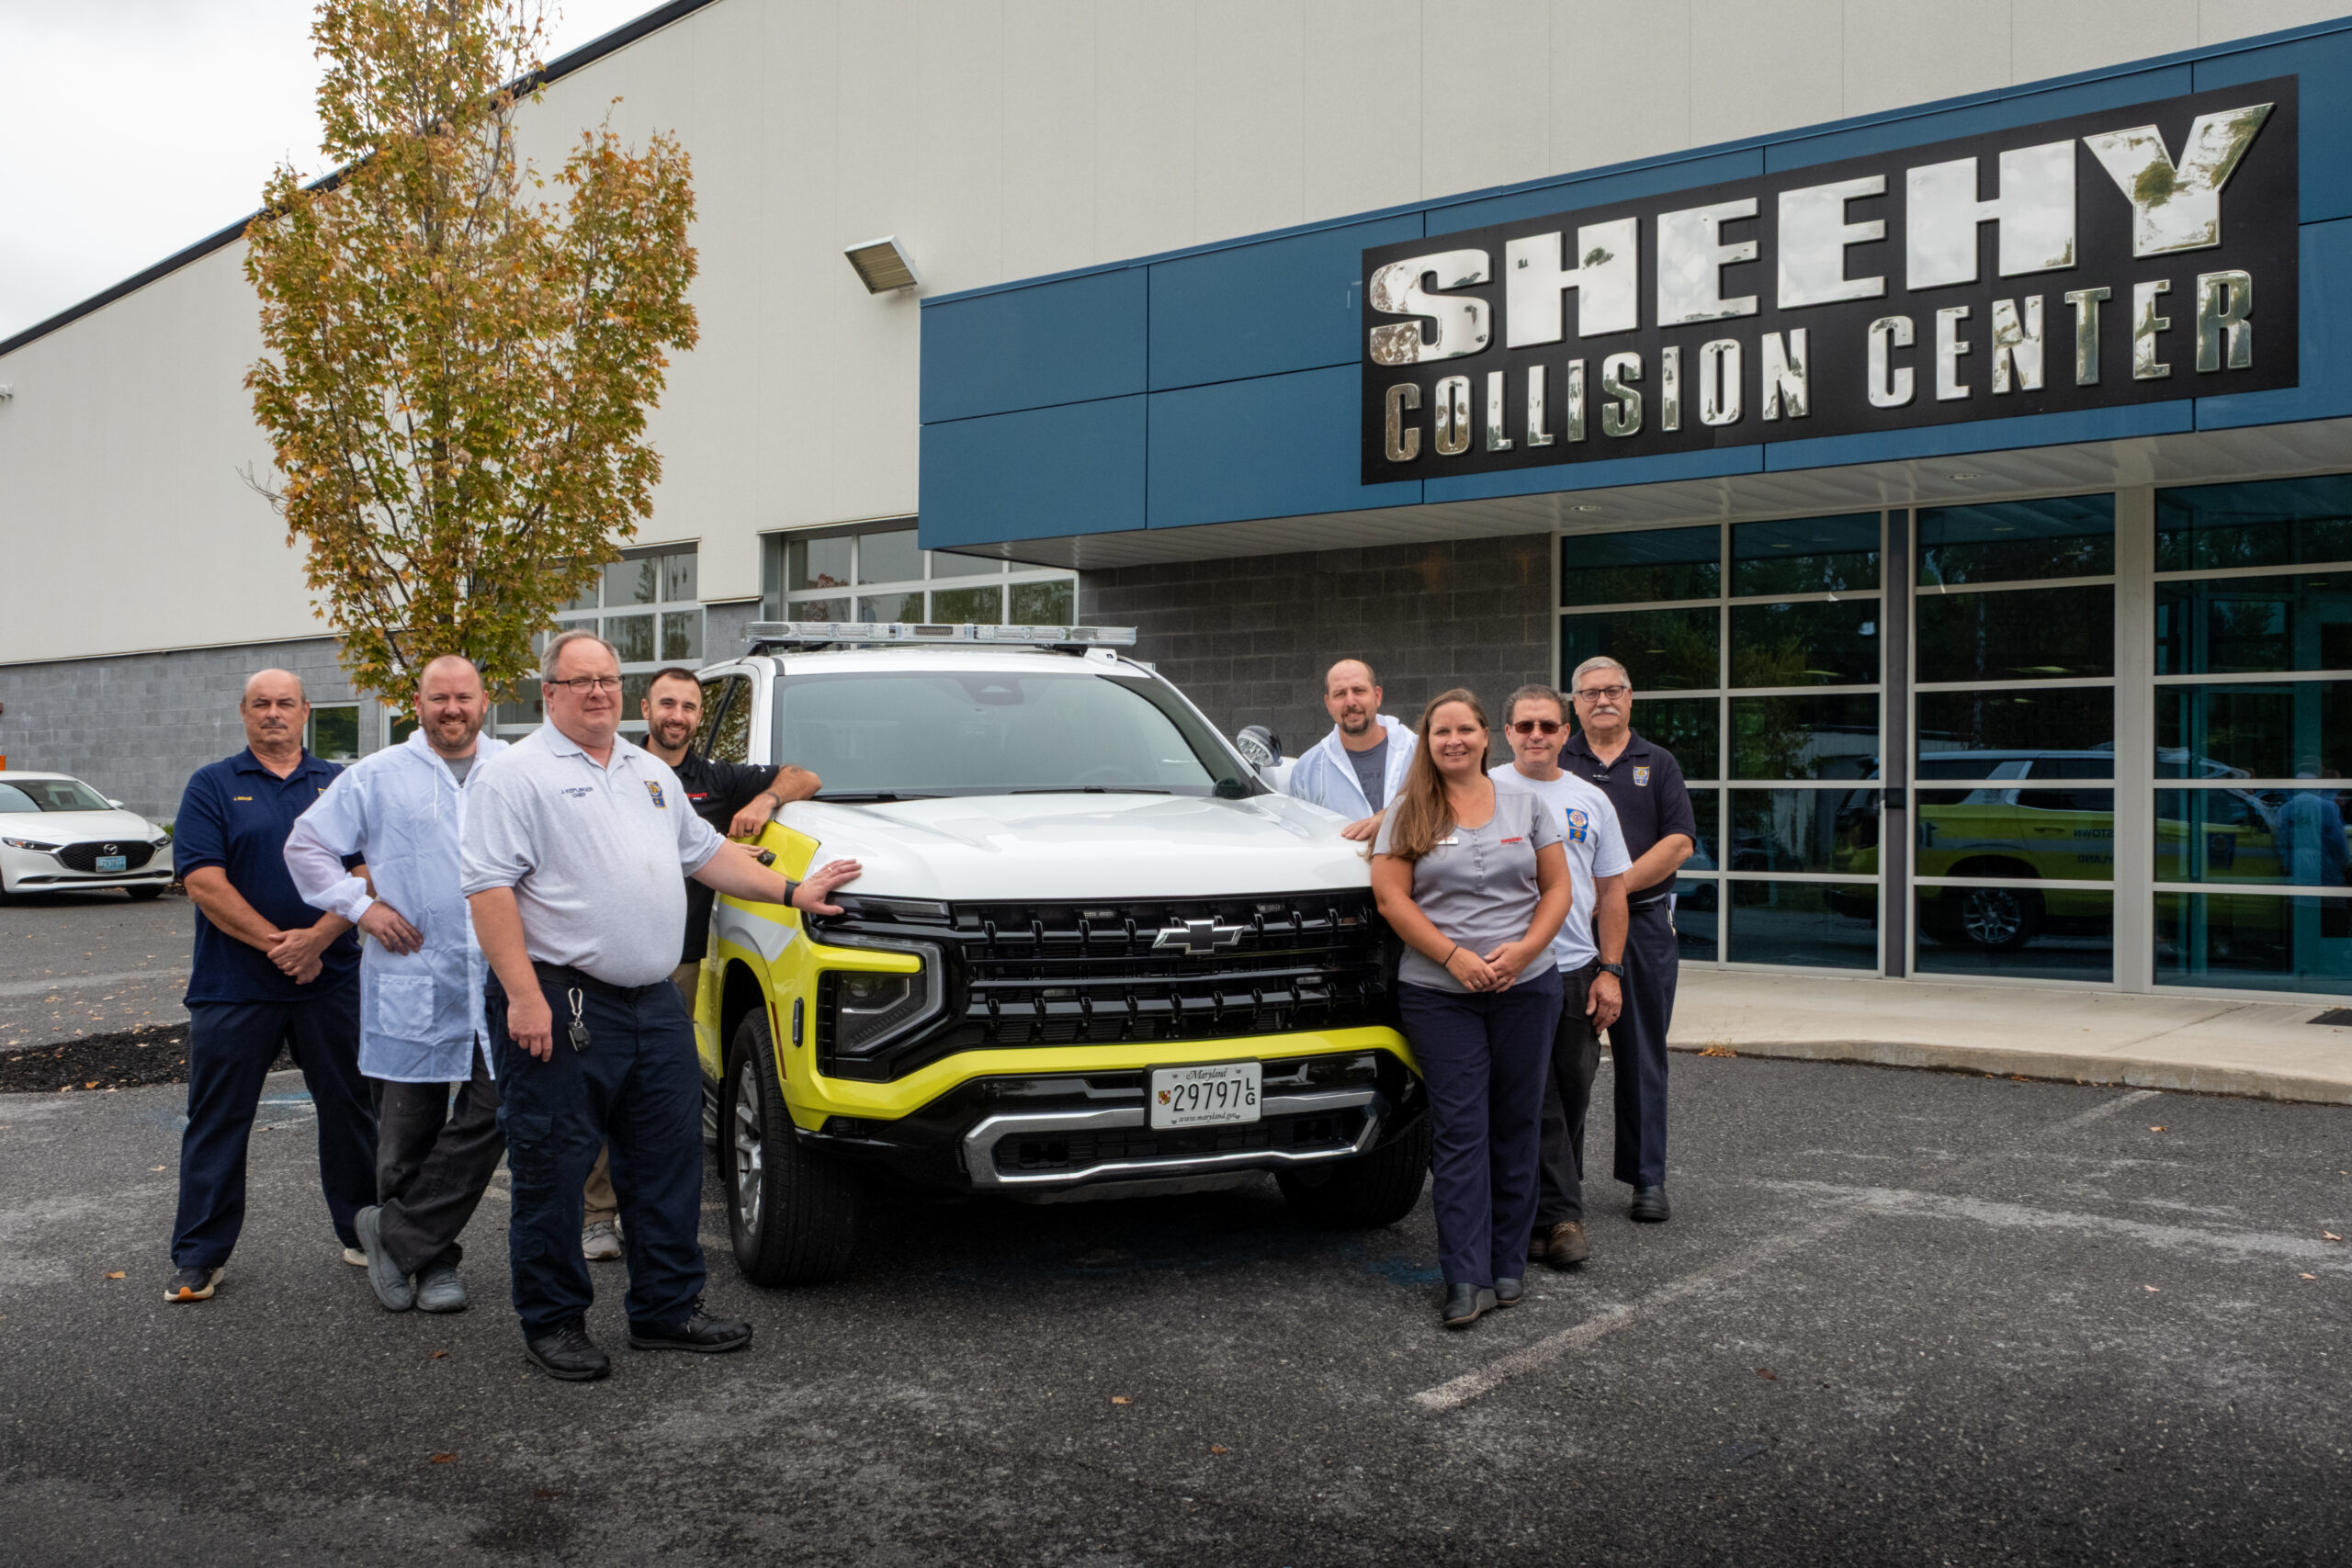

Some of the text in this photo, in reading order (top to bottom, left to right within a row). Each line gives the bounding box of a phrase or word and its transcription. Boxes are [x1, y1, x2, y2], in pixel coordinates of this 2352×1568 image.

[1369, 101, 2277, 367] SHEEHY
[1385, 268, 2254, 463] COLLISION CENTER
[1173, 1079, 1241, 1111] 29797
[1186, 1067, 1227, 1081] Maryland
